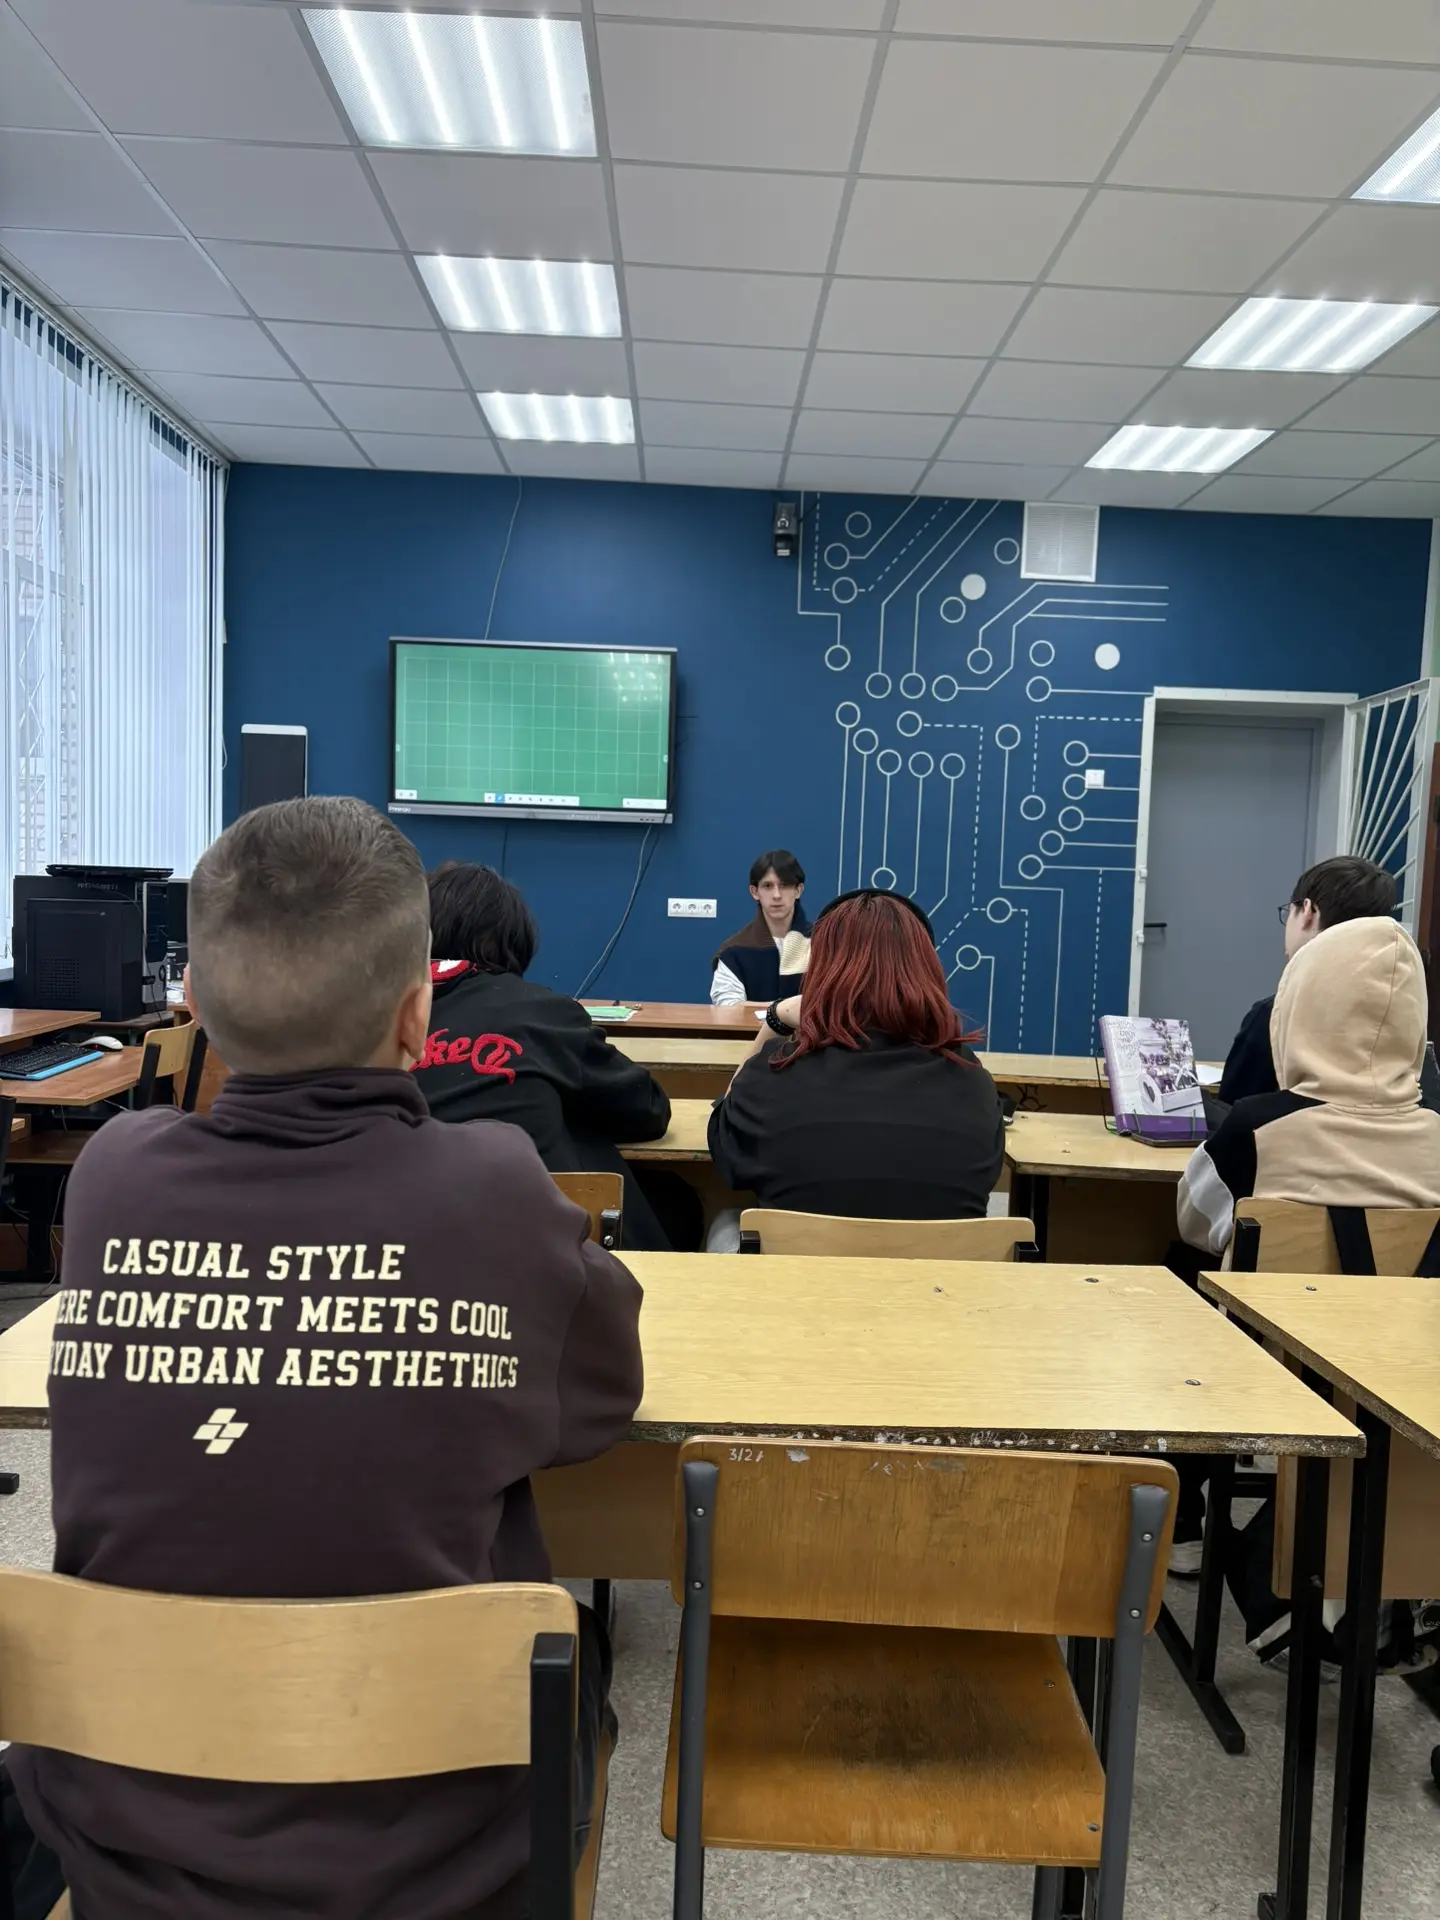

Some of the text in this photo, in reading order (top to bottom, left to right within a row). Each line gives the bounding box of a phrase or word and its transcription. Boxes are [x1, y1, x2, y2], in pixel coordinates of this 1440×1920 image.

[102, 1238, 406, 1281] CASUAL STYLE
[56, 1289, 512, 1341] ERE COMFORT MEETS COOL
[50, 1340, 520, 1389] YDAY URBAN AESTHETHICS
